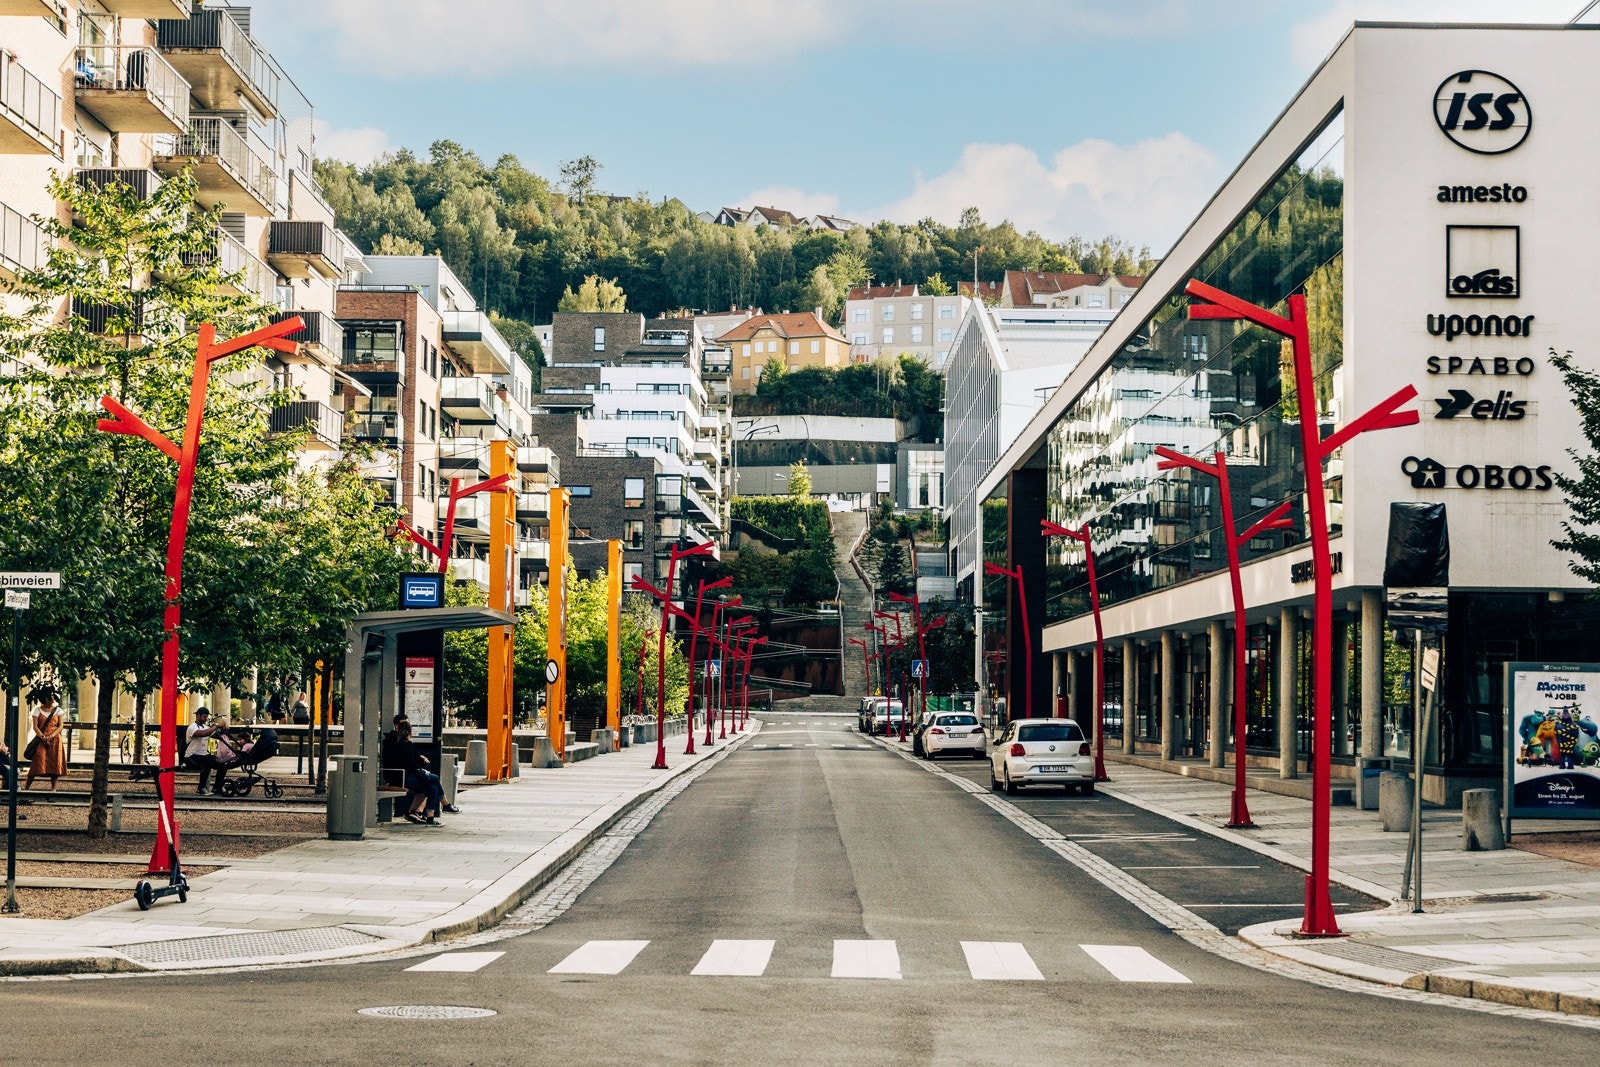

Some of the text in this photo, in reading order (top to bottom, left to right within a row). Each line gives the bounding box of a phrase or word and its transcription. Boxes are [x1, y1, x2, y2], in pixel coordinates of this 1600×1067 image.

[1437, 183, 1528, 204] amesto
[1452, 268, 1514, 294] oras
[1427, 314, 1535, 342] uponor
[1427, 355, 1535, 377] SPABO
[1471, 389, 1528, 420] elis
[1455, 464, 1553, 490] OBOS
[0, 575, 53, 586] binveien
